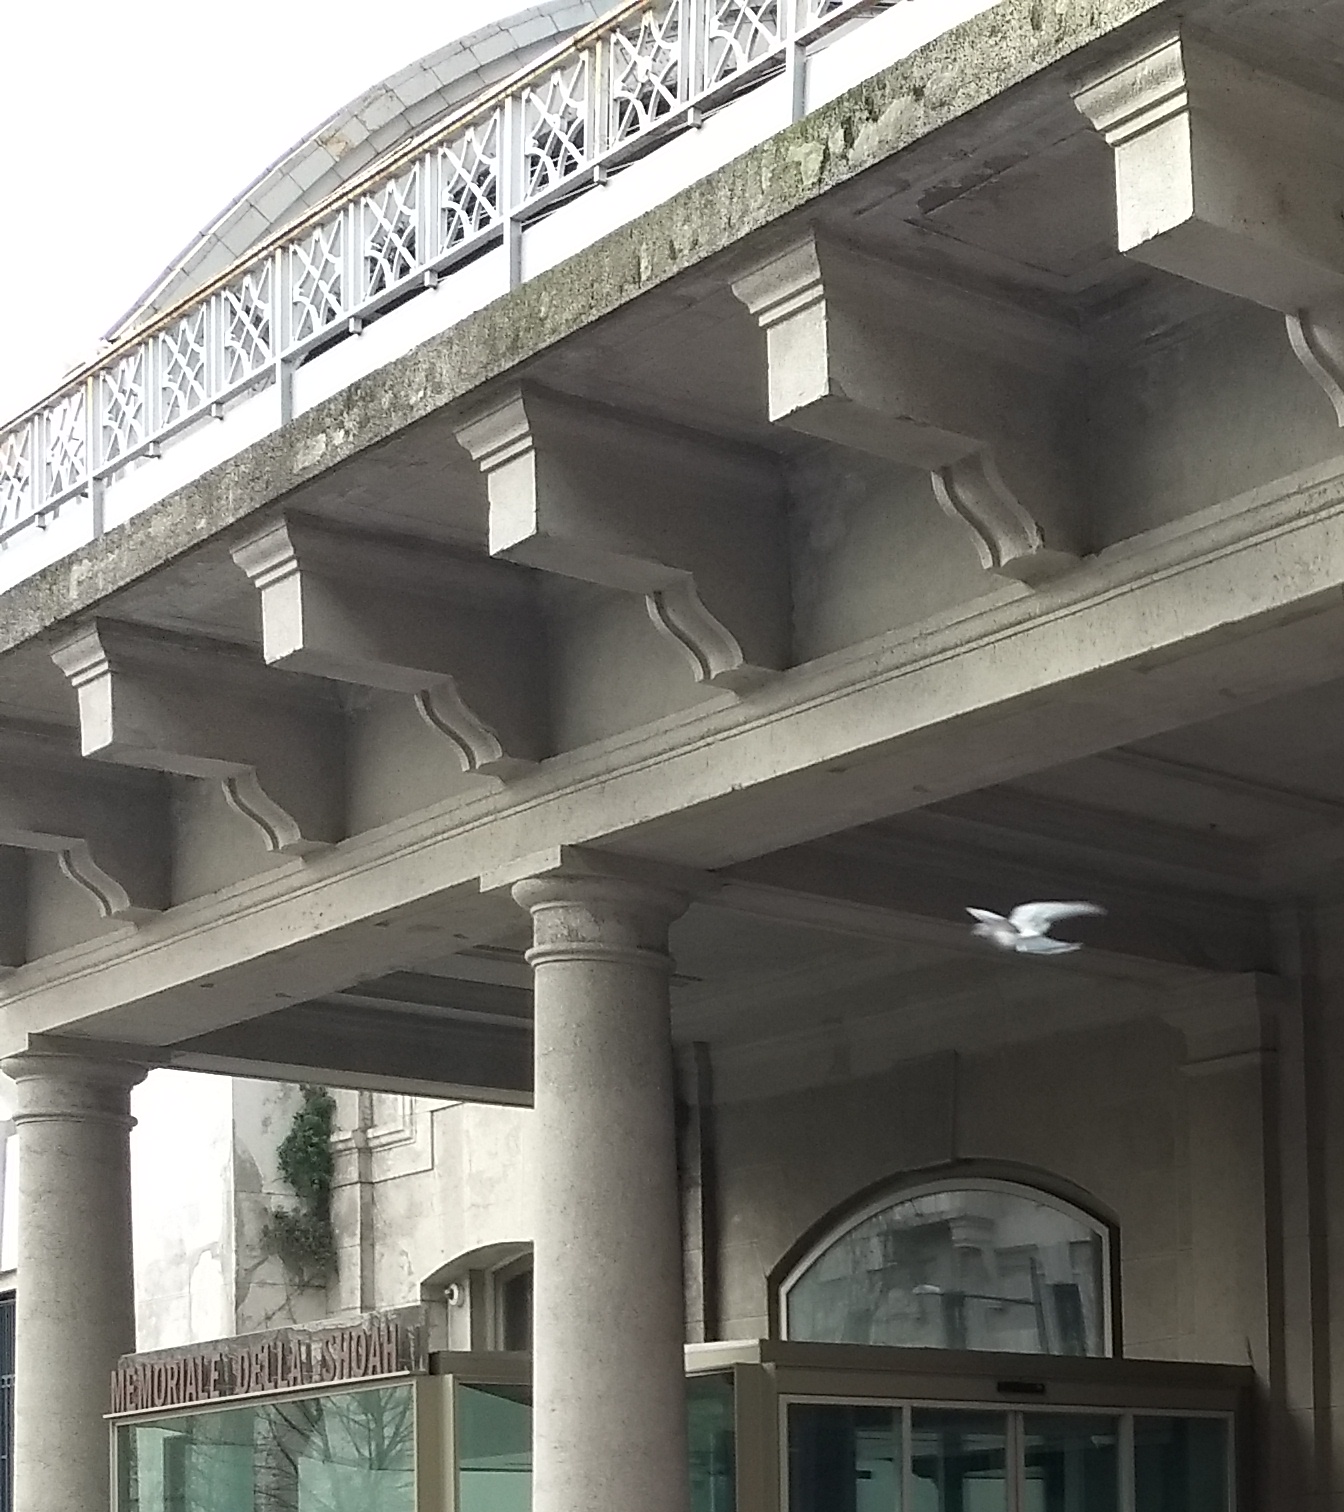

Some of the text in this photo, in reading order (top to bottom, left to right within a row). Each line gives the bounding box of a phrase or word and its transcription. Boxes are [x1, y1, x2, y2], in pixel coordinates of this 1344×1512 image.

[110, 1322, 398, 1413] MEMORIALE DELLA SHOAH
